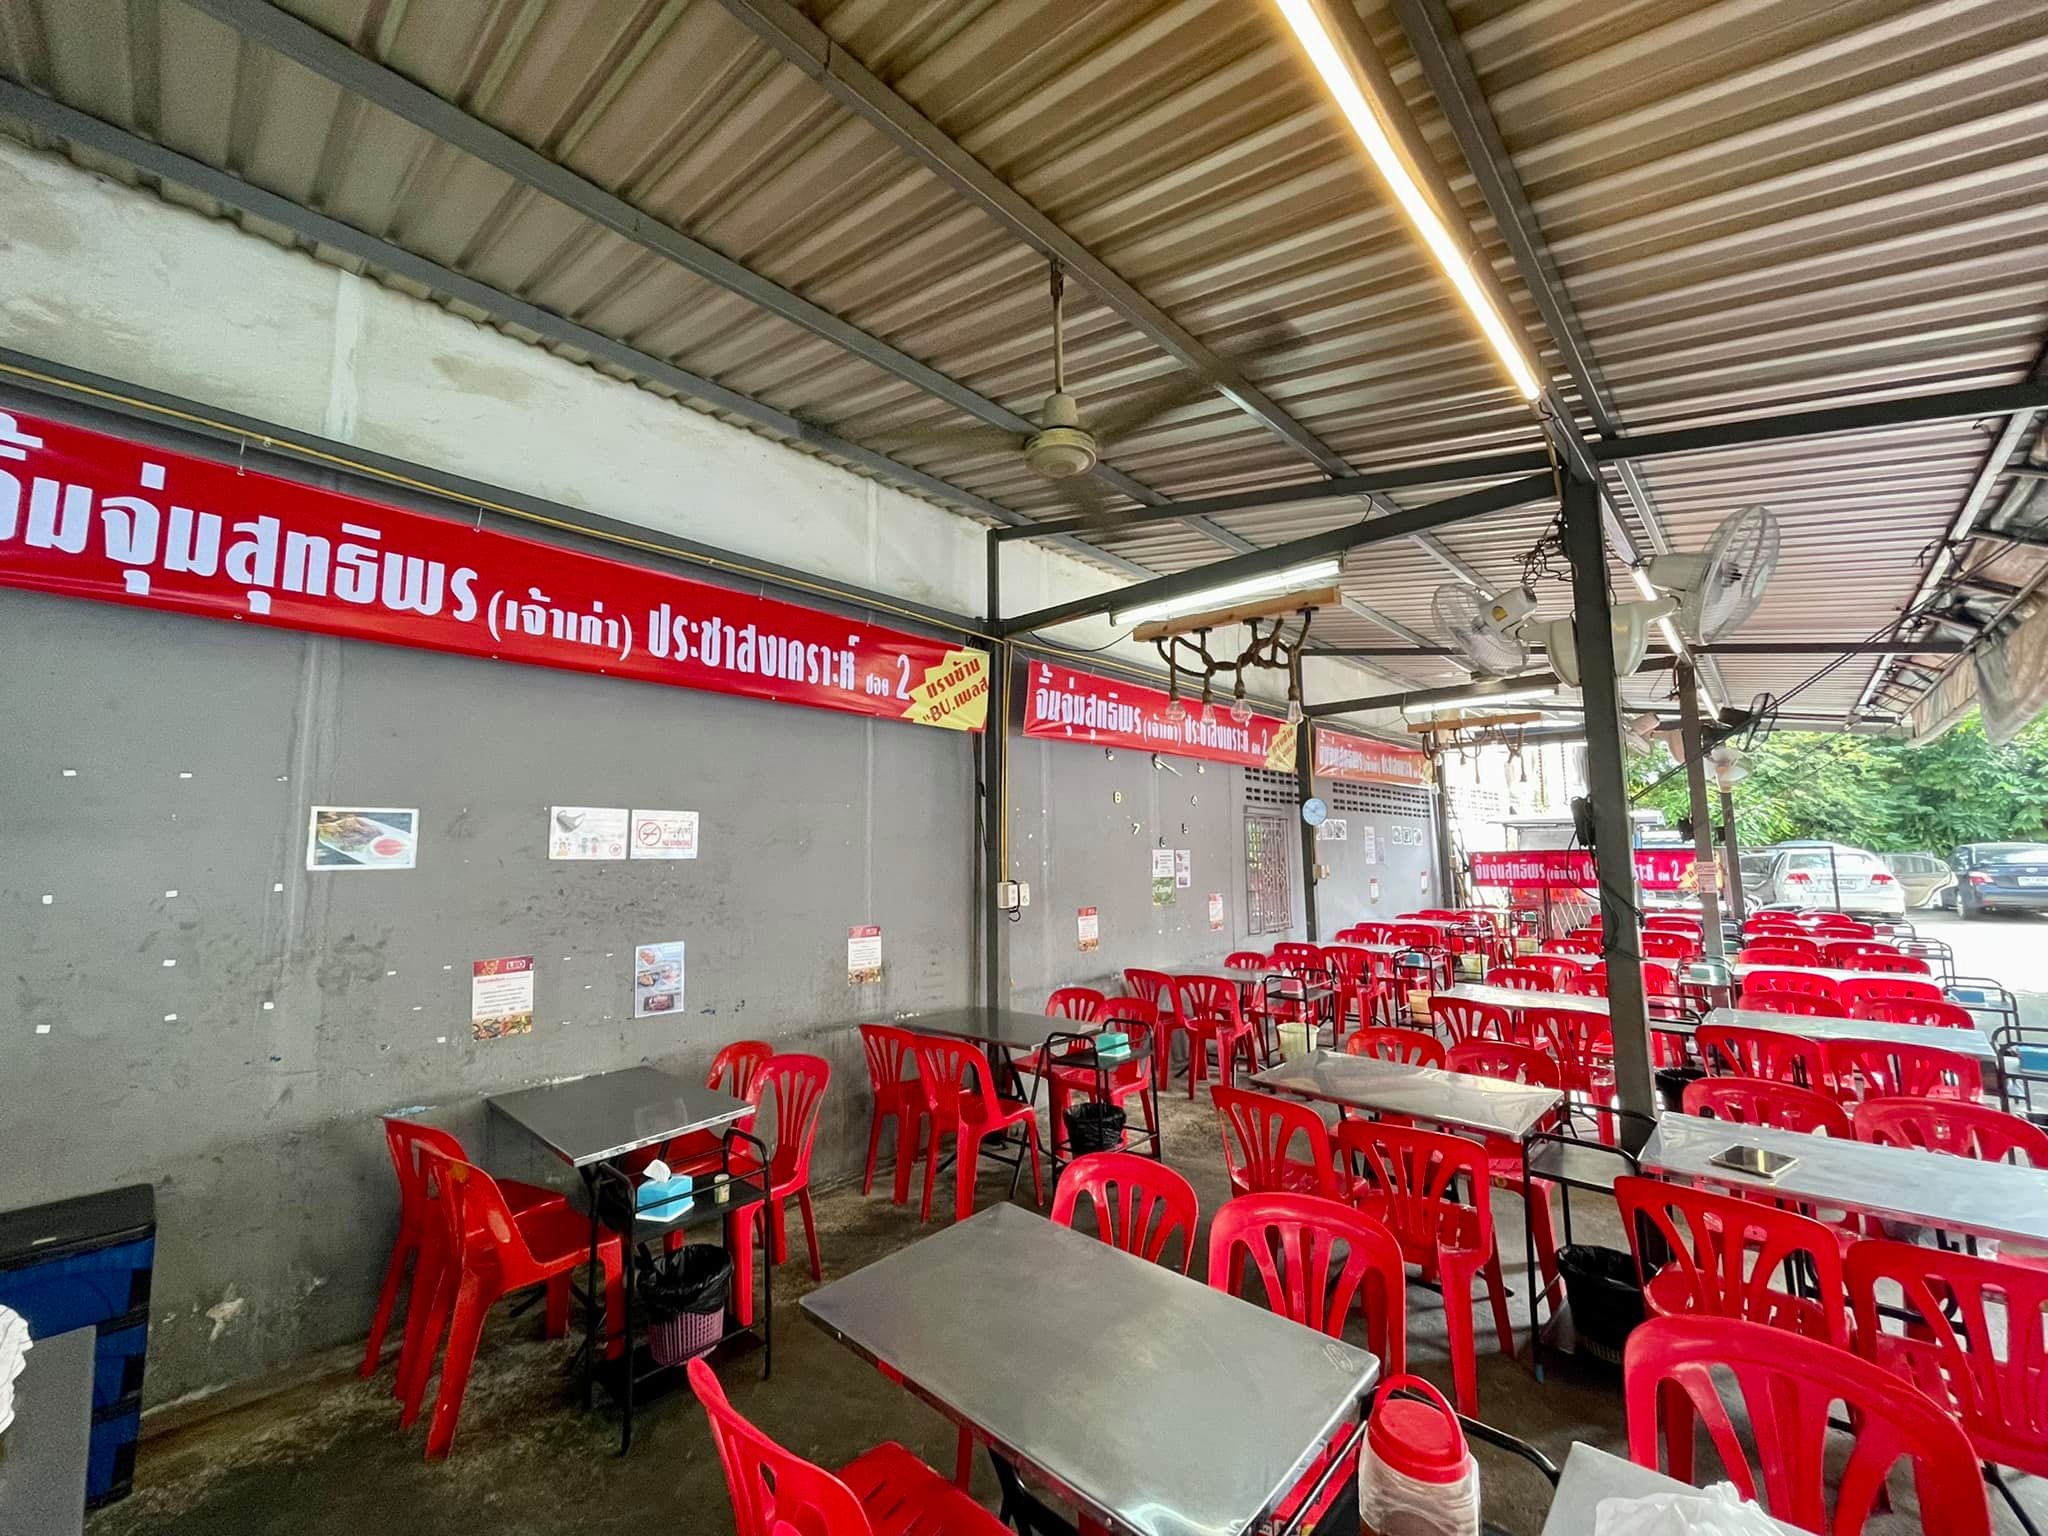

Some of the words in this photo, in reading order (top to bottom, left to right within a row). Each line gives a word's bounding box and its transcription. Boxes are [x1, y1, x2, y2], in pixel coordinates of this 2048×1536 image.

[488, 587, 633, 662] (เจ้าเก่า)
[648, 603, 860, 691] ประชาสงเคราะห์
[866, 673, 889, 696] ซอย
[896, 654, 910, 700] 2
[1036, 664, 1142, 740] จิ้มจุ่มสุทธิพร
[1262, 728, 1268, 756] 2
[1671, 860, 1681, 882] 2
